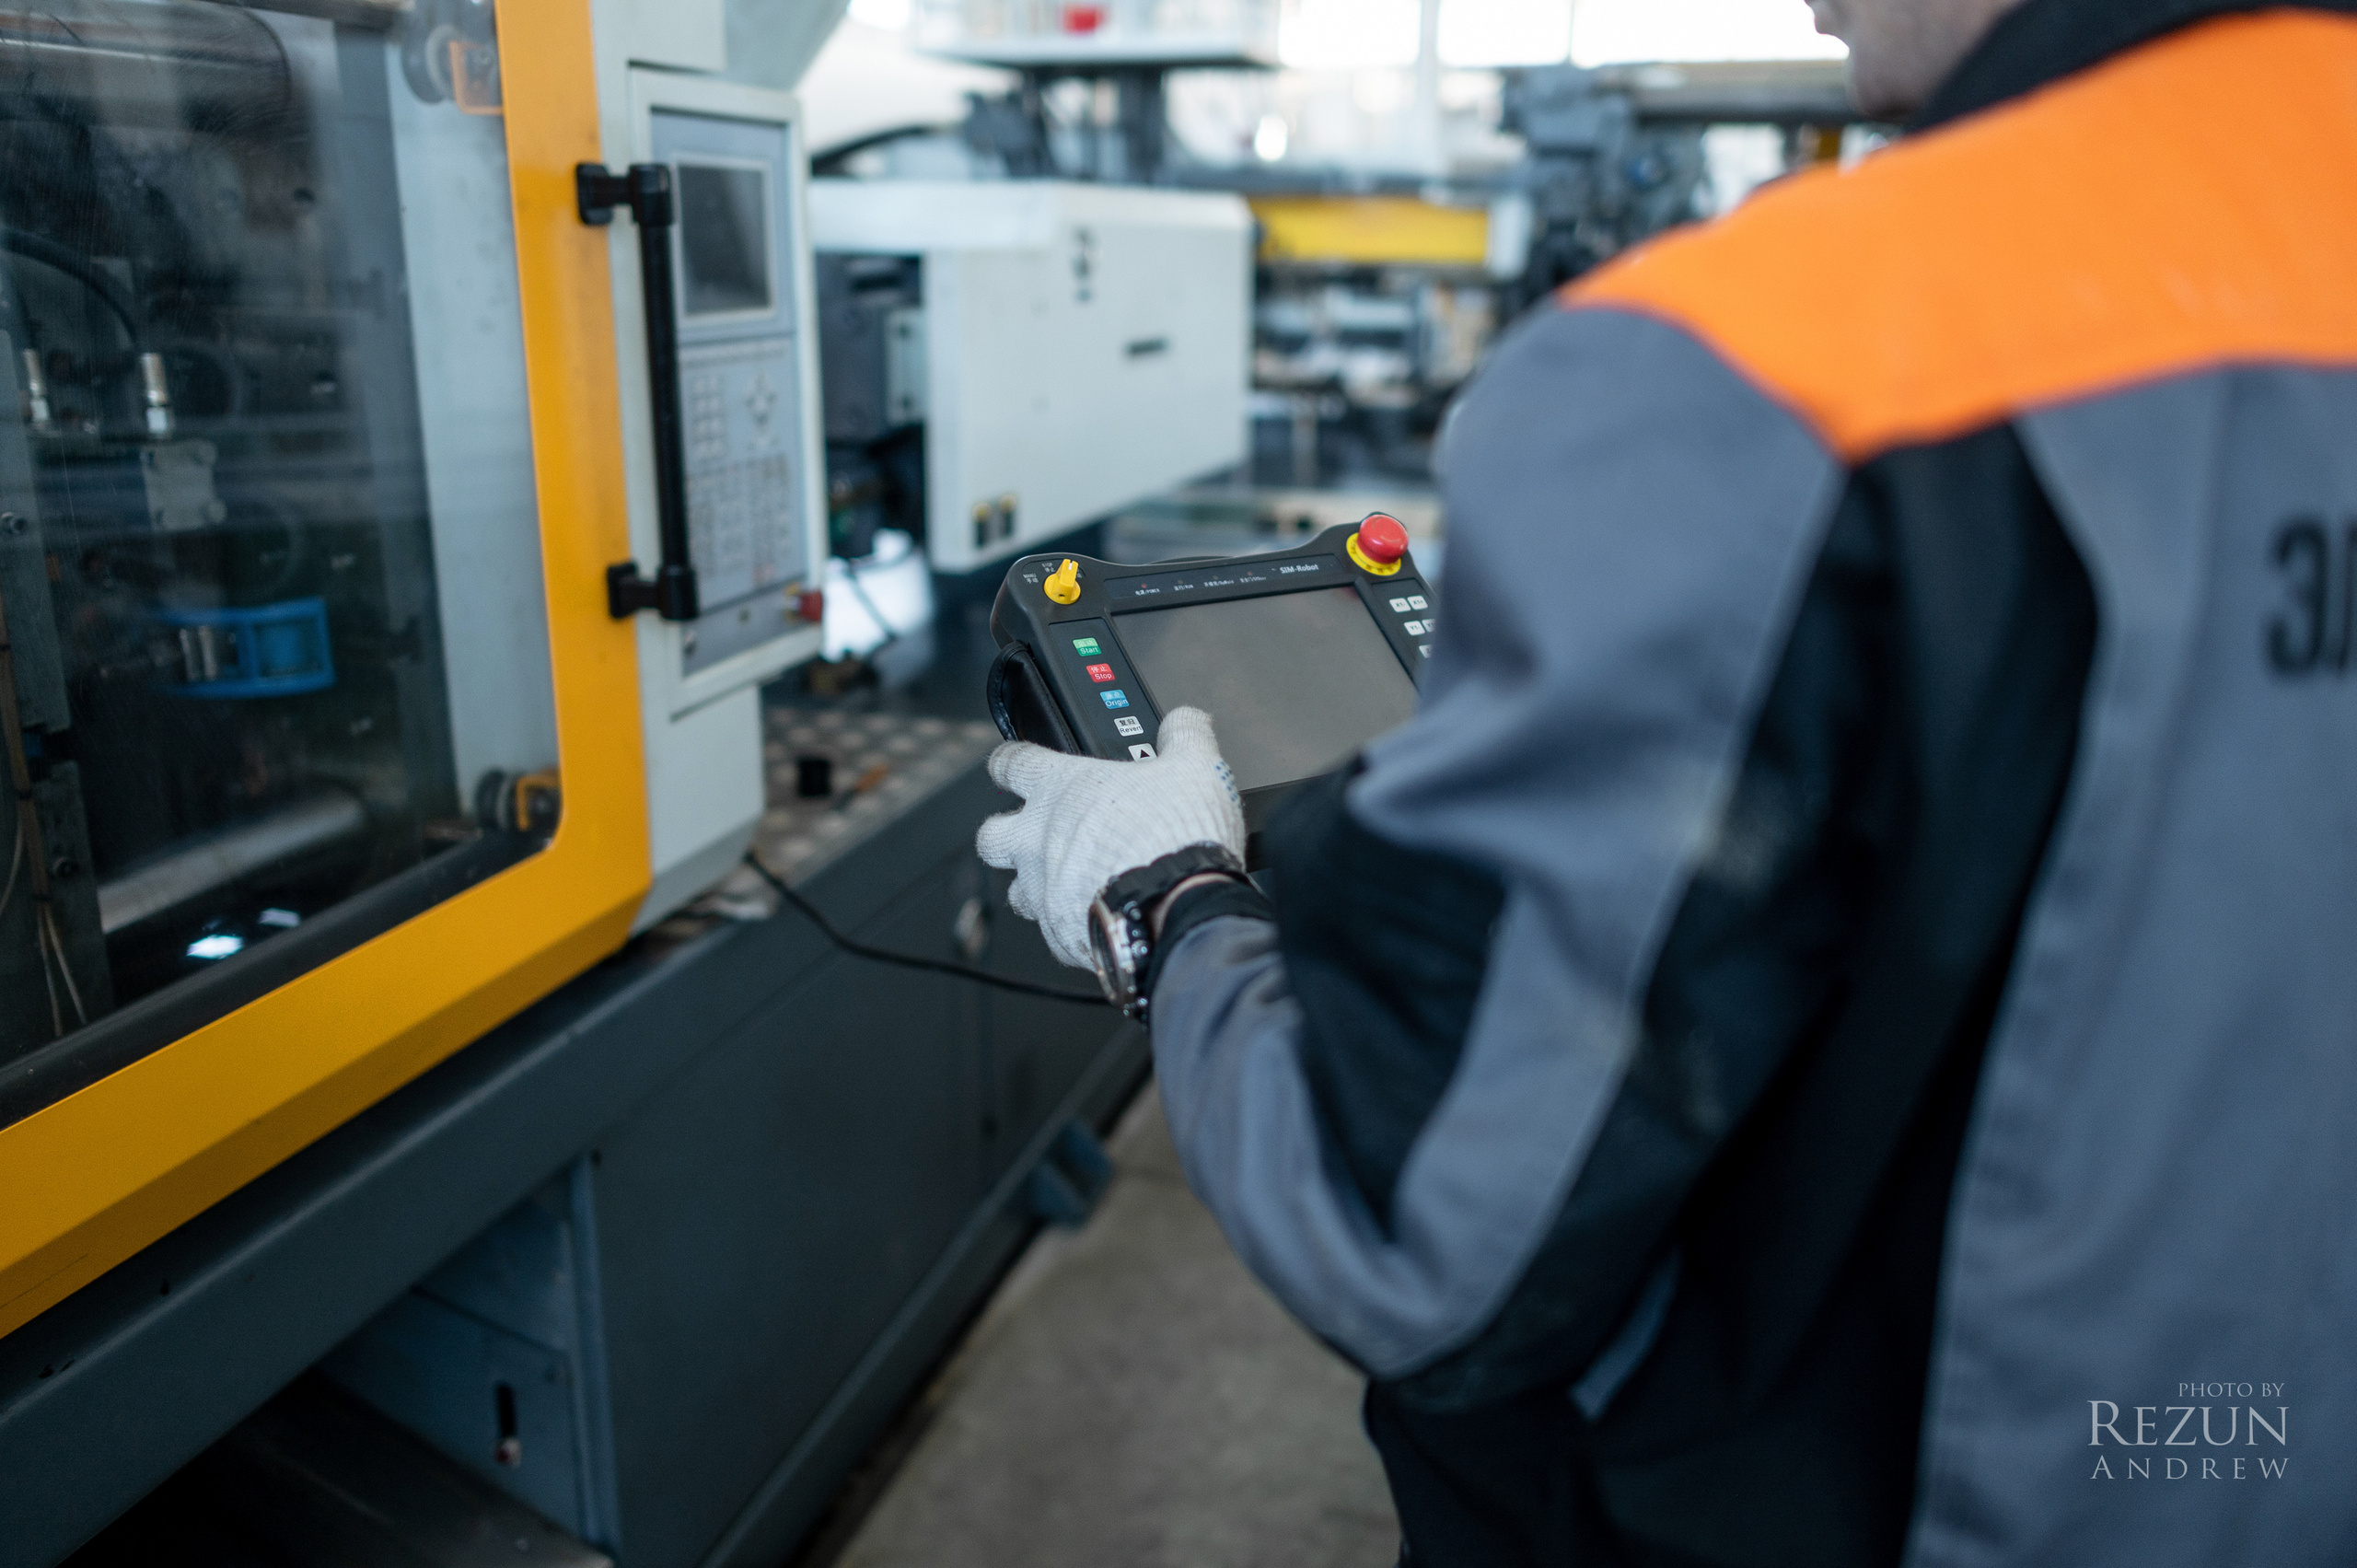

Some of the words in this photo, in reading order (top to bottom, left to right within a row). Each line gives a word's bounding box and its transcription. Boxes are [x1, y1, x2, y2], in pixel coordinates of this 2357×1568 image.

[1280, 563, 1319, 574] SIM-Robot
[1080, 646, 1099, 655] Start
[1090, 665, 1108, 673] 停止
[1105, 698, 1129, 707] Origin
[1119, 718, 1135, 726] 复归
[1120, 726, 1143, 734] Revert
